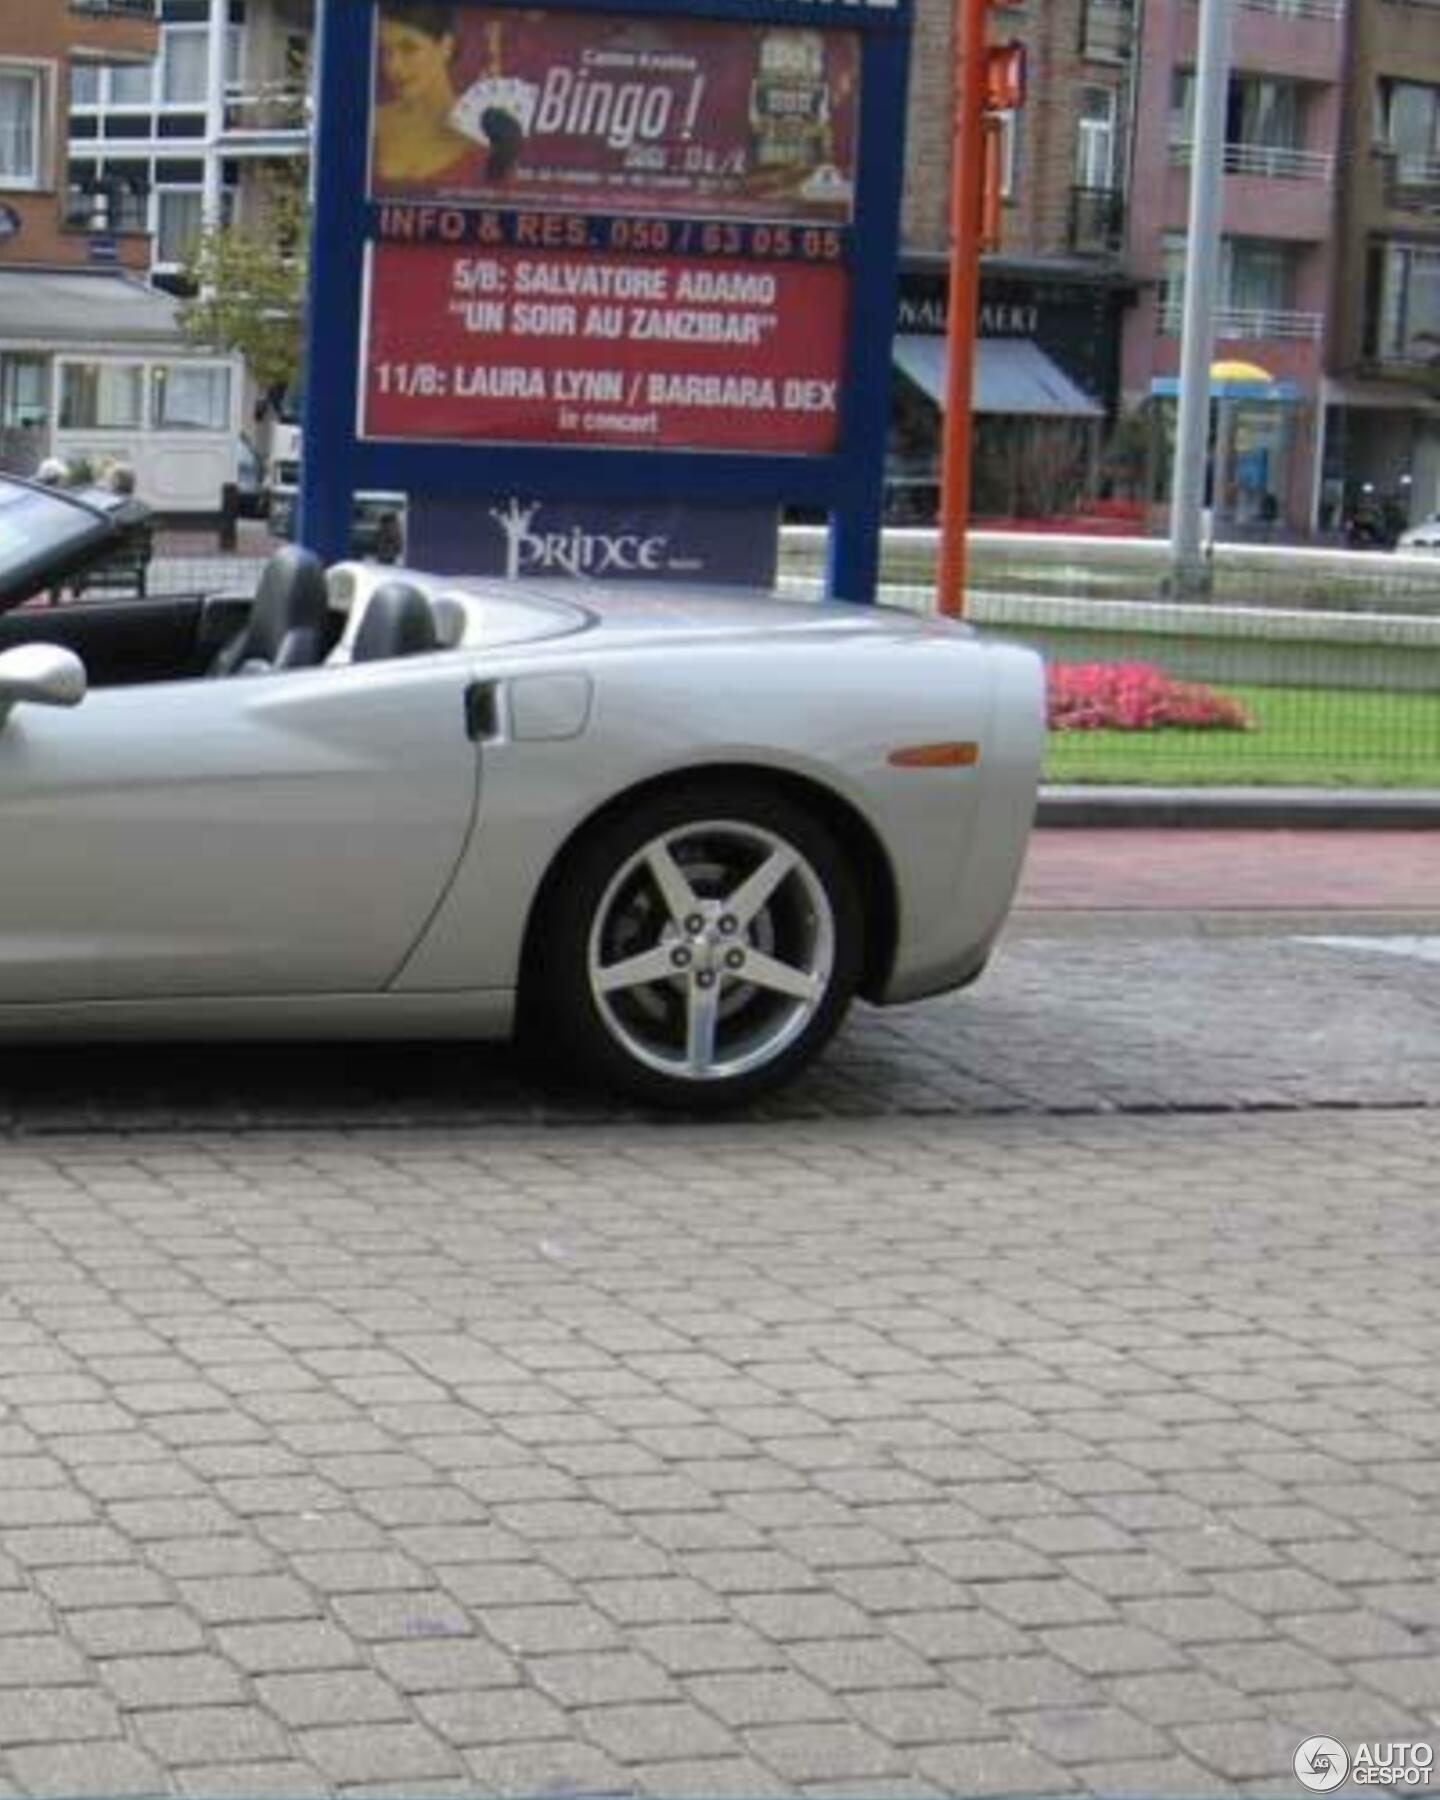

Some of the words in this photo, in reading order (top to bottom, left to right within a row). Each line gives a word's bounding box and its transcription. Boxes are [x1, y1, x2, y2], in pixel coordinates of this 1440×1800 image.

[536, 66, 674, 149] Bingo
[380, 206, 466, 240] INFO
[477, 210, 503, 242] &
[516, 213, 601, 246] RES.
[514, 261, 668, 300] SALVATORE
[675, 270, 776, 305] ADAMO
[512, 302, 577, 336] SOIR
[583, 306, 624, 339] AU
[455, 365, 547, 398] LAURA
[553, 368, 623, 402] LYNN
[646, 373, 776, 410] BARBARA
[782, 378, 838, 411] DEX
[558, 404, 579, 430] in
[584, 408, 658, 433] concert
